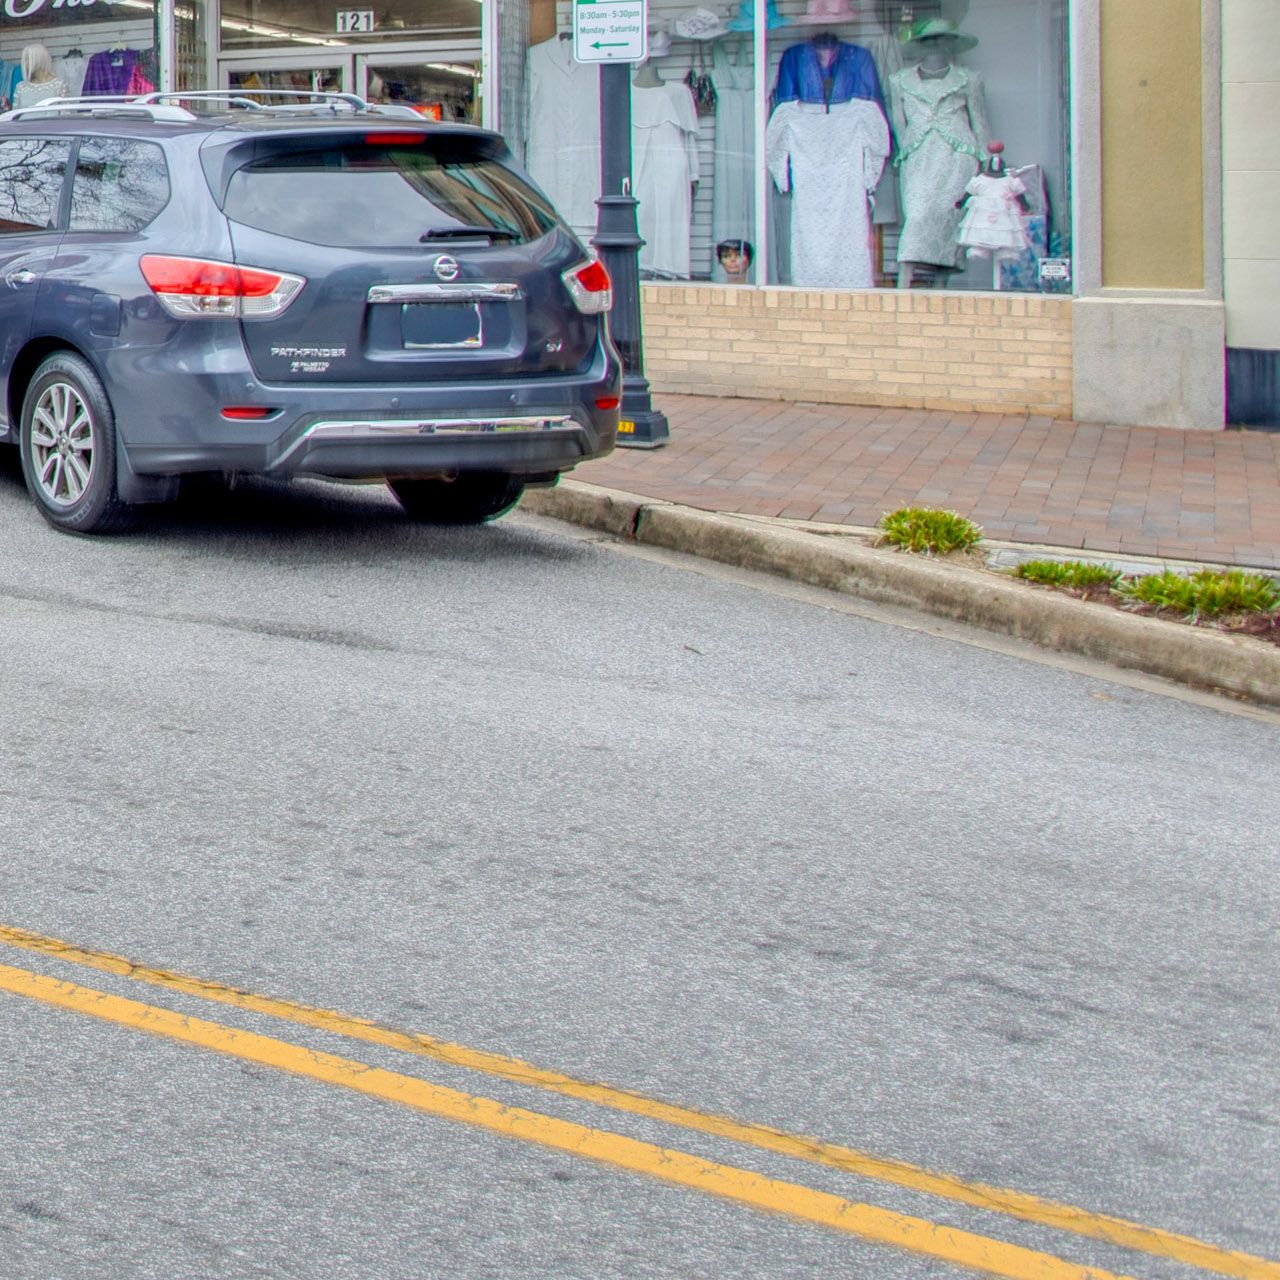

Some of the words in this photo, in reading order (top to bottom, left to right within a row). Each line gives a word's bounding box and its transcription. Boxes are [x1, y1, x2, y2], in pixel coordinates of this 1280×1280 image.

[611, 9, 640, 19] 5:30pm
[340, 12, 372, 32] 121
[579, 26, 605, 35] Monday
[609, 24, 640, 34] Saturday
[270, 347, 346, 358] PATHFINDER
